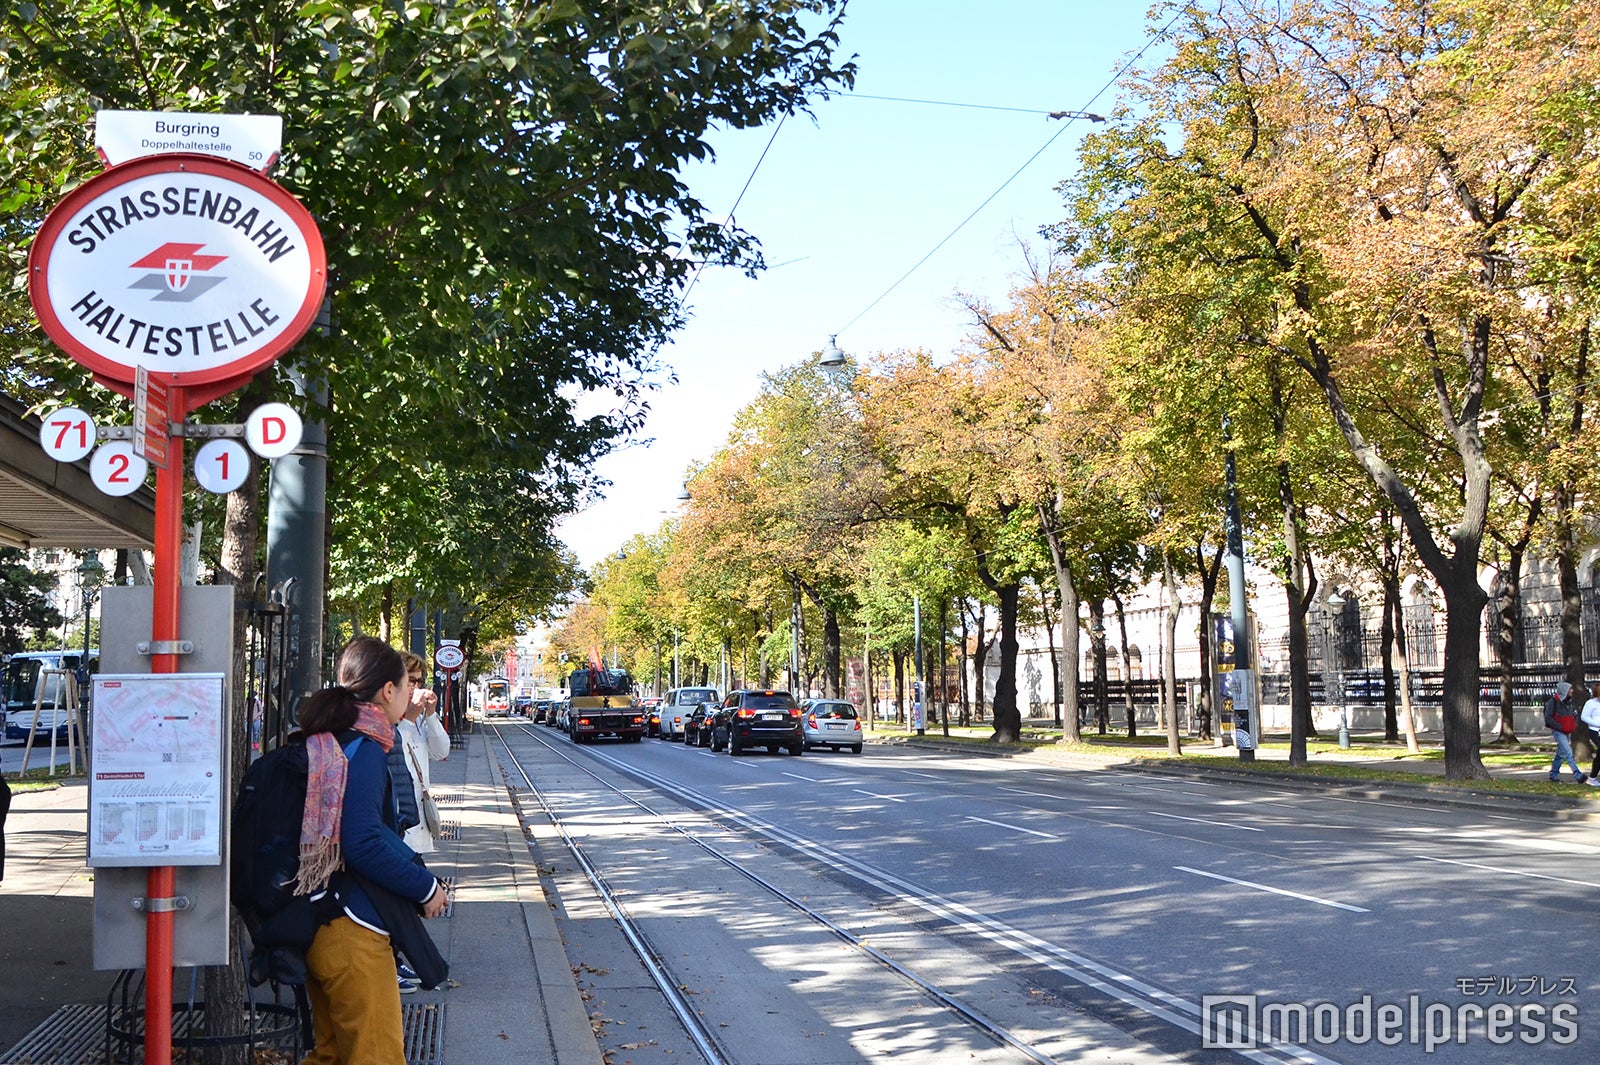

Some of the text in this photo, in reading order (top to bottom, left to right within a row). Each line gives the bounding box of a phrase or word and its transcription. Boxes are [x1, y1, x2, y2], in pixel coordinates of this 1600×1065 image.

[155, 121, 220, 138] Burgring
[141, 139, 232, 152] Doppelhaltestelle
[248, 152, 263, 161] 50
[68, 186, 295, 264] STRASSENBAHN
[70, 290, 280, 356] HALTESTELLE
[51, 421, 87, 449] 71
[262, 417, 286, 444] D
[108, 454, 130, 483] 2
[215, 452, 229, 481] 1
